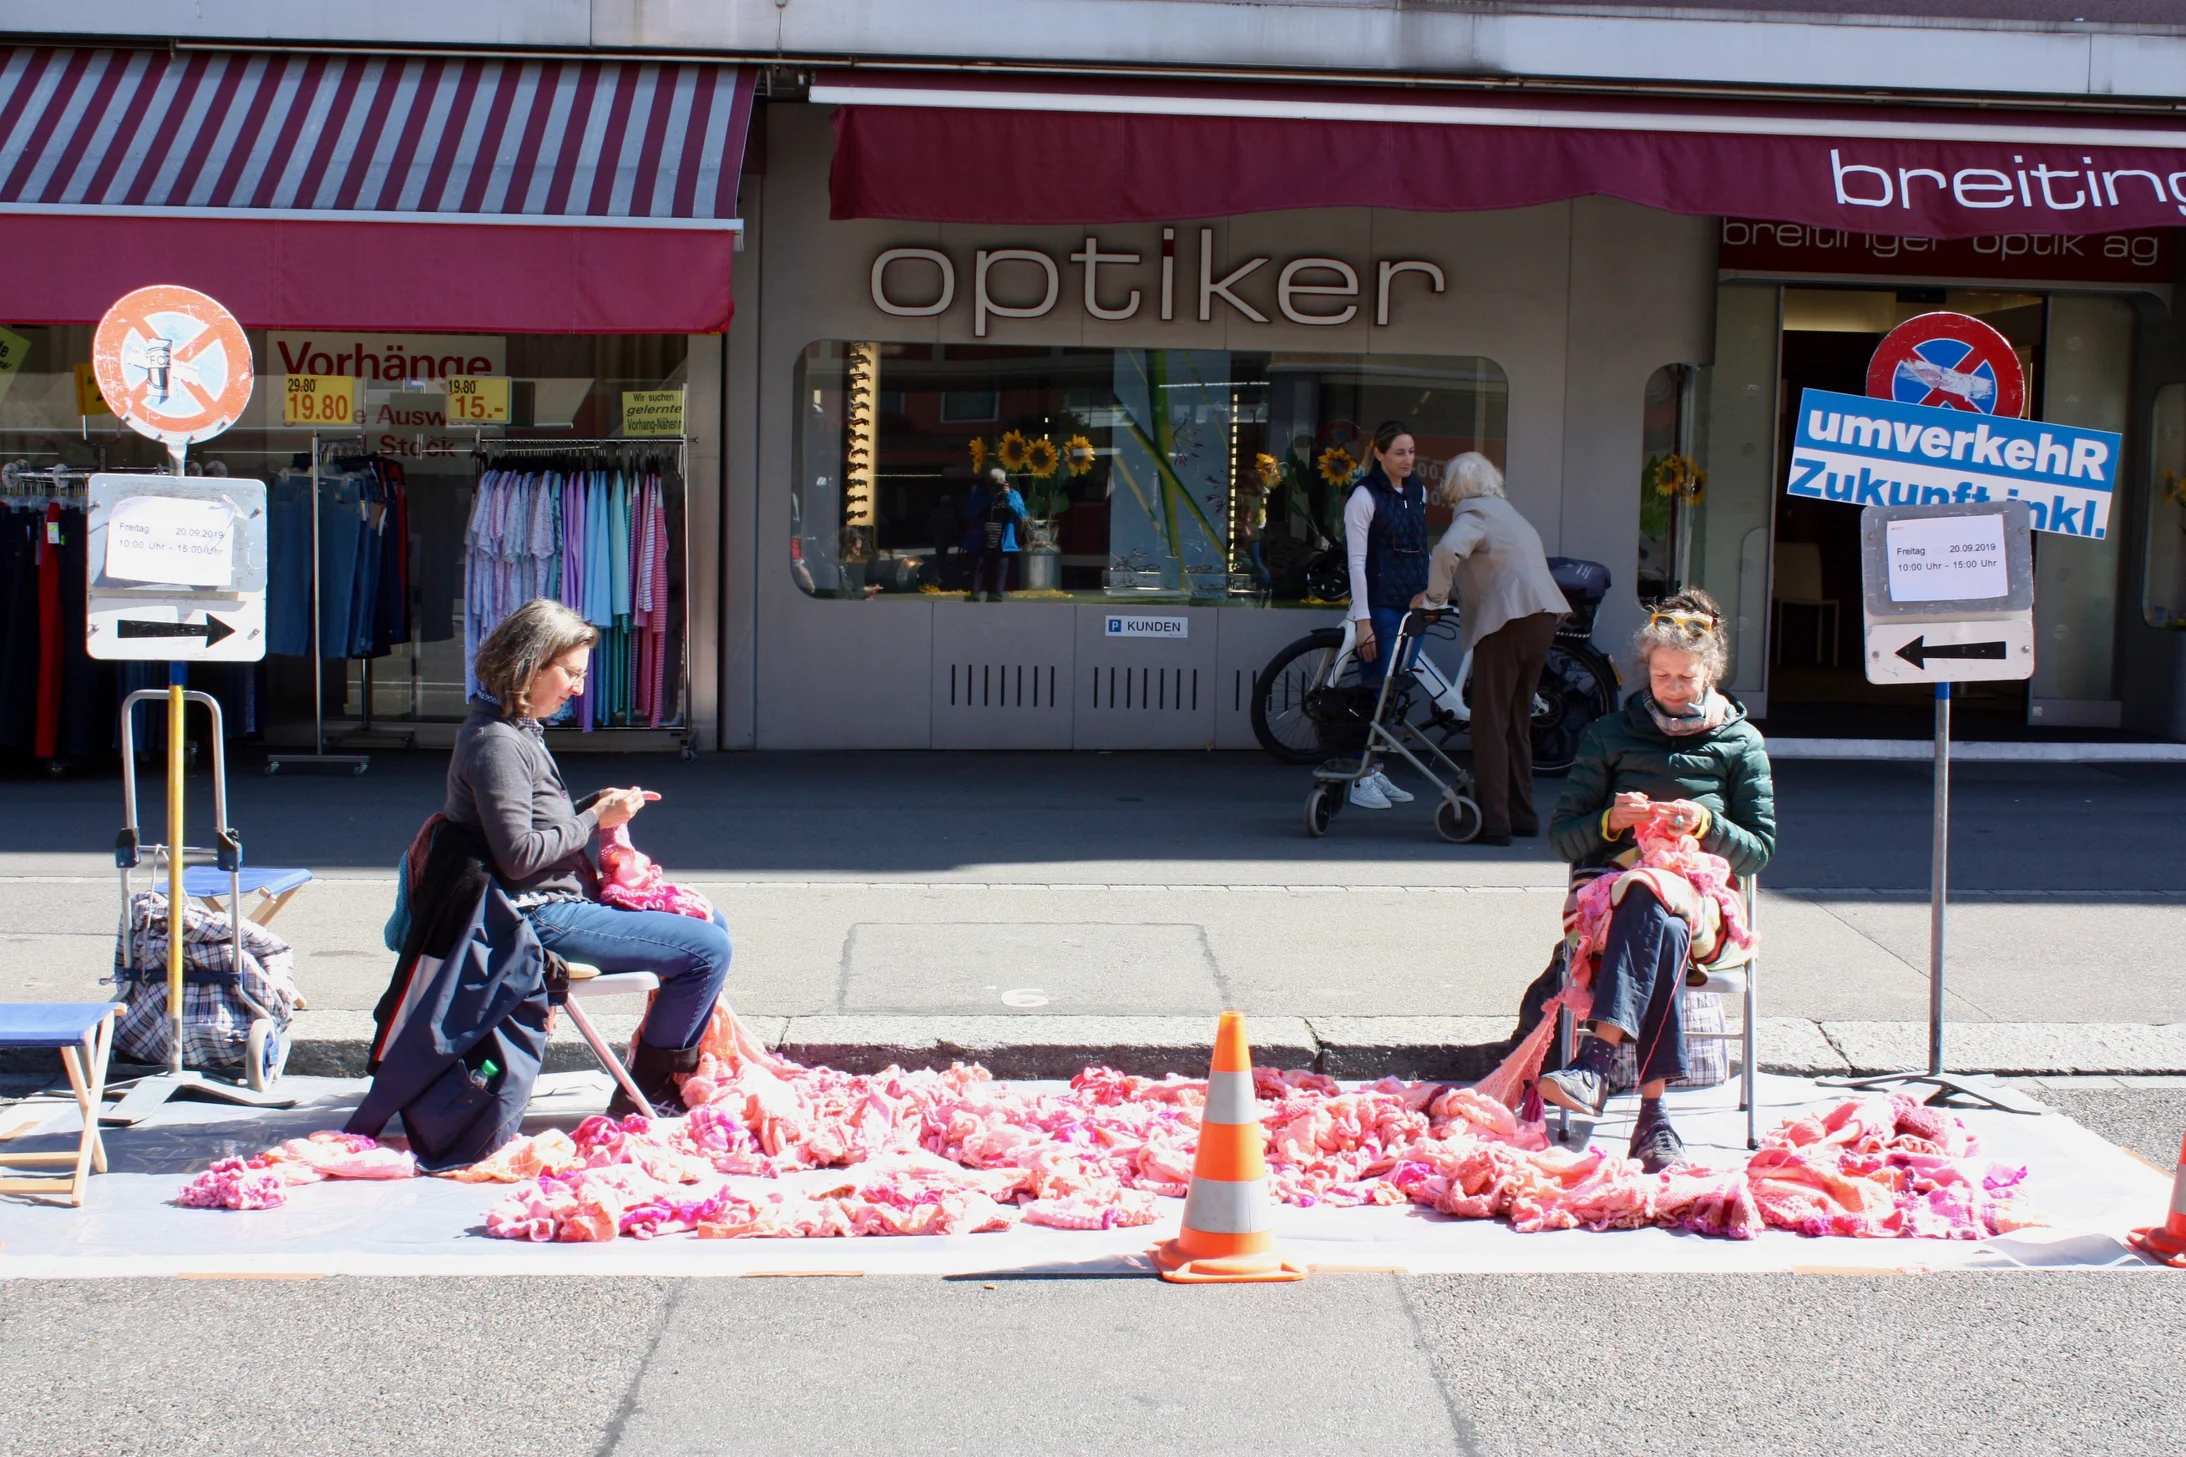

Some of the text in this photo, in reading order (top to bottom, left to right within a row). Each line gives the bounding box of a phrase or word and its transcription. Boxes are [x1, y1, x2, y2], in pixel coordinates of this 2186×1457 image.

[2103, 235, 2158, 266] ag
[870, 227, 1446, 337] optiker
[288, 378, 316, 392] 29.80
[448, 379, 476, 394] 19.80
[633, 393, 675, 402] Wir suchen
[289, 394, 348, 420] 19.80
[455, 395, 503, 419] 15.-
[626, 404, 682, 417] gelernte
[376, 404, 447, 426] Ausw
[1808, 409, 2108, 481] umverkehR
[119, 522, 224, 540] Freitag 20.09.2019
[149, 542, 165, 550] Uhr
[1896, 542, 1996, 557] Freitag 20.09.2019
[1898, 562, 1922, 572] 10:00
[1926, 562, 1942, 571] Uhr
[1953, 560, 1977, 569] 15:00
[1981, 559, 1997, 568] Uhr
[1127, 621, 1181, 632] KUNDEN
